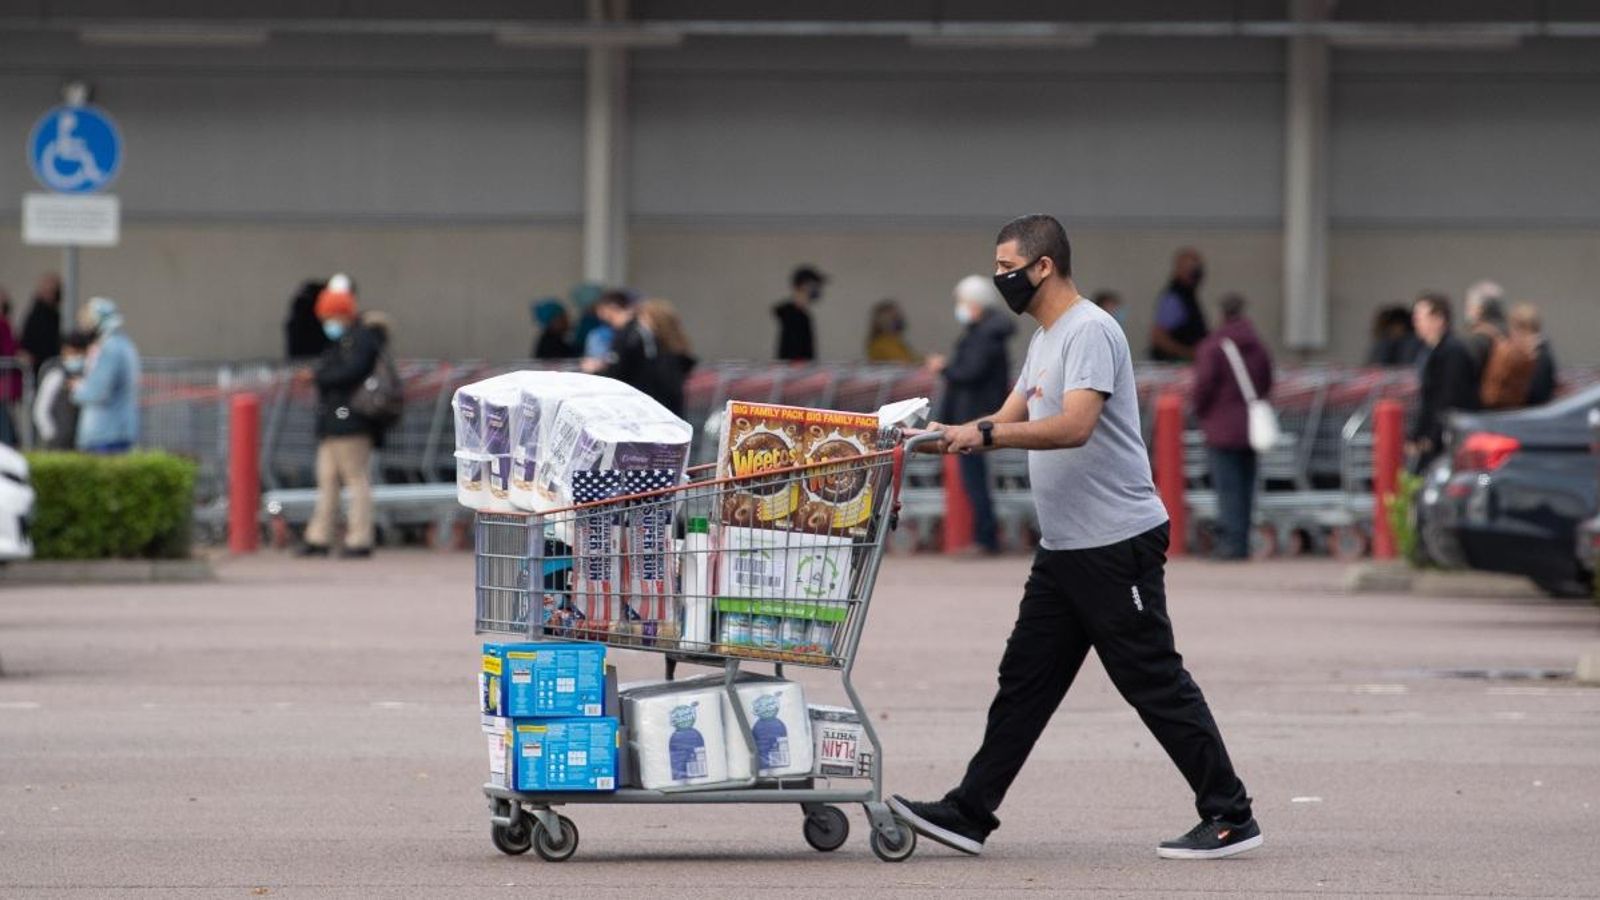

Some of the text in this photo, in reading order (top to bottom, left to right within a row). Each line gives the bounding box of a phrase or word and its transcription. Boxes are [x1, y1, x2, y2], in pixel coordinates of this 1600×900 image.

[732, 404, 804, 421] BIG FAMILY PACK
[806, 411, 878, 427] BIG FAMILY PACK
[732, 447, 797, 477] Weetos
[589, 507, 603, 550] SUPER
[642, 506, 657, 580] SUPER BUN
[821, 739, 856, 759] PLAIN
